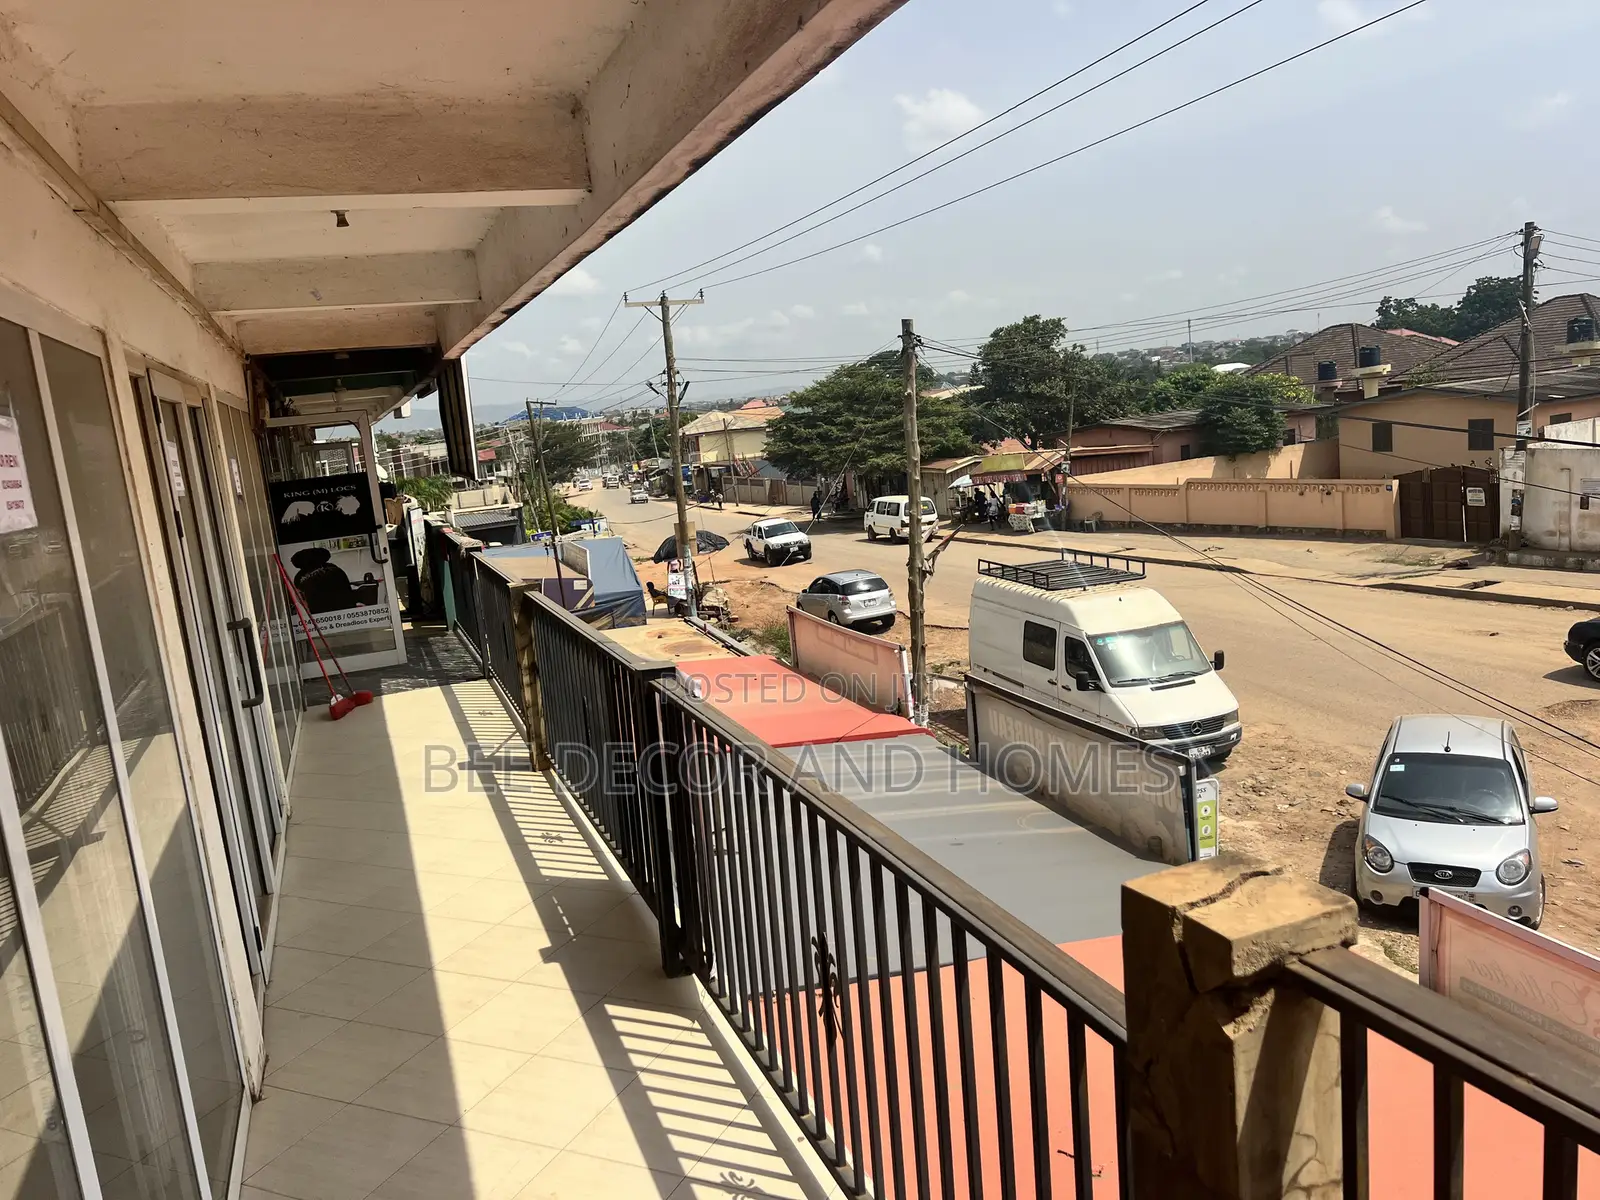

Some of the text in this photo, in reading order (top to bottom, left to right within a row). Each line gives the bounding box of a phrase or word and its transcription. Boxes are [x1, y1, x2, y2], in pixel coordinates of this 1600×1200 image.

[283, 485, 357, 499] KING (M) LOCS
[335, 618, 368, 628] Dreadlocs
[369, 614, 390, 624] Expert
